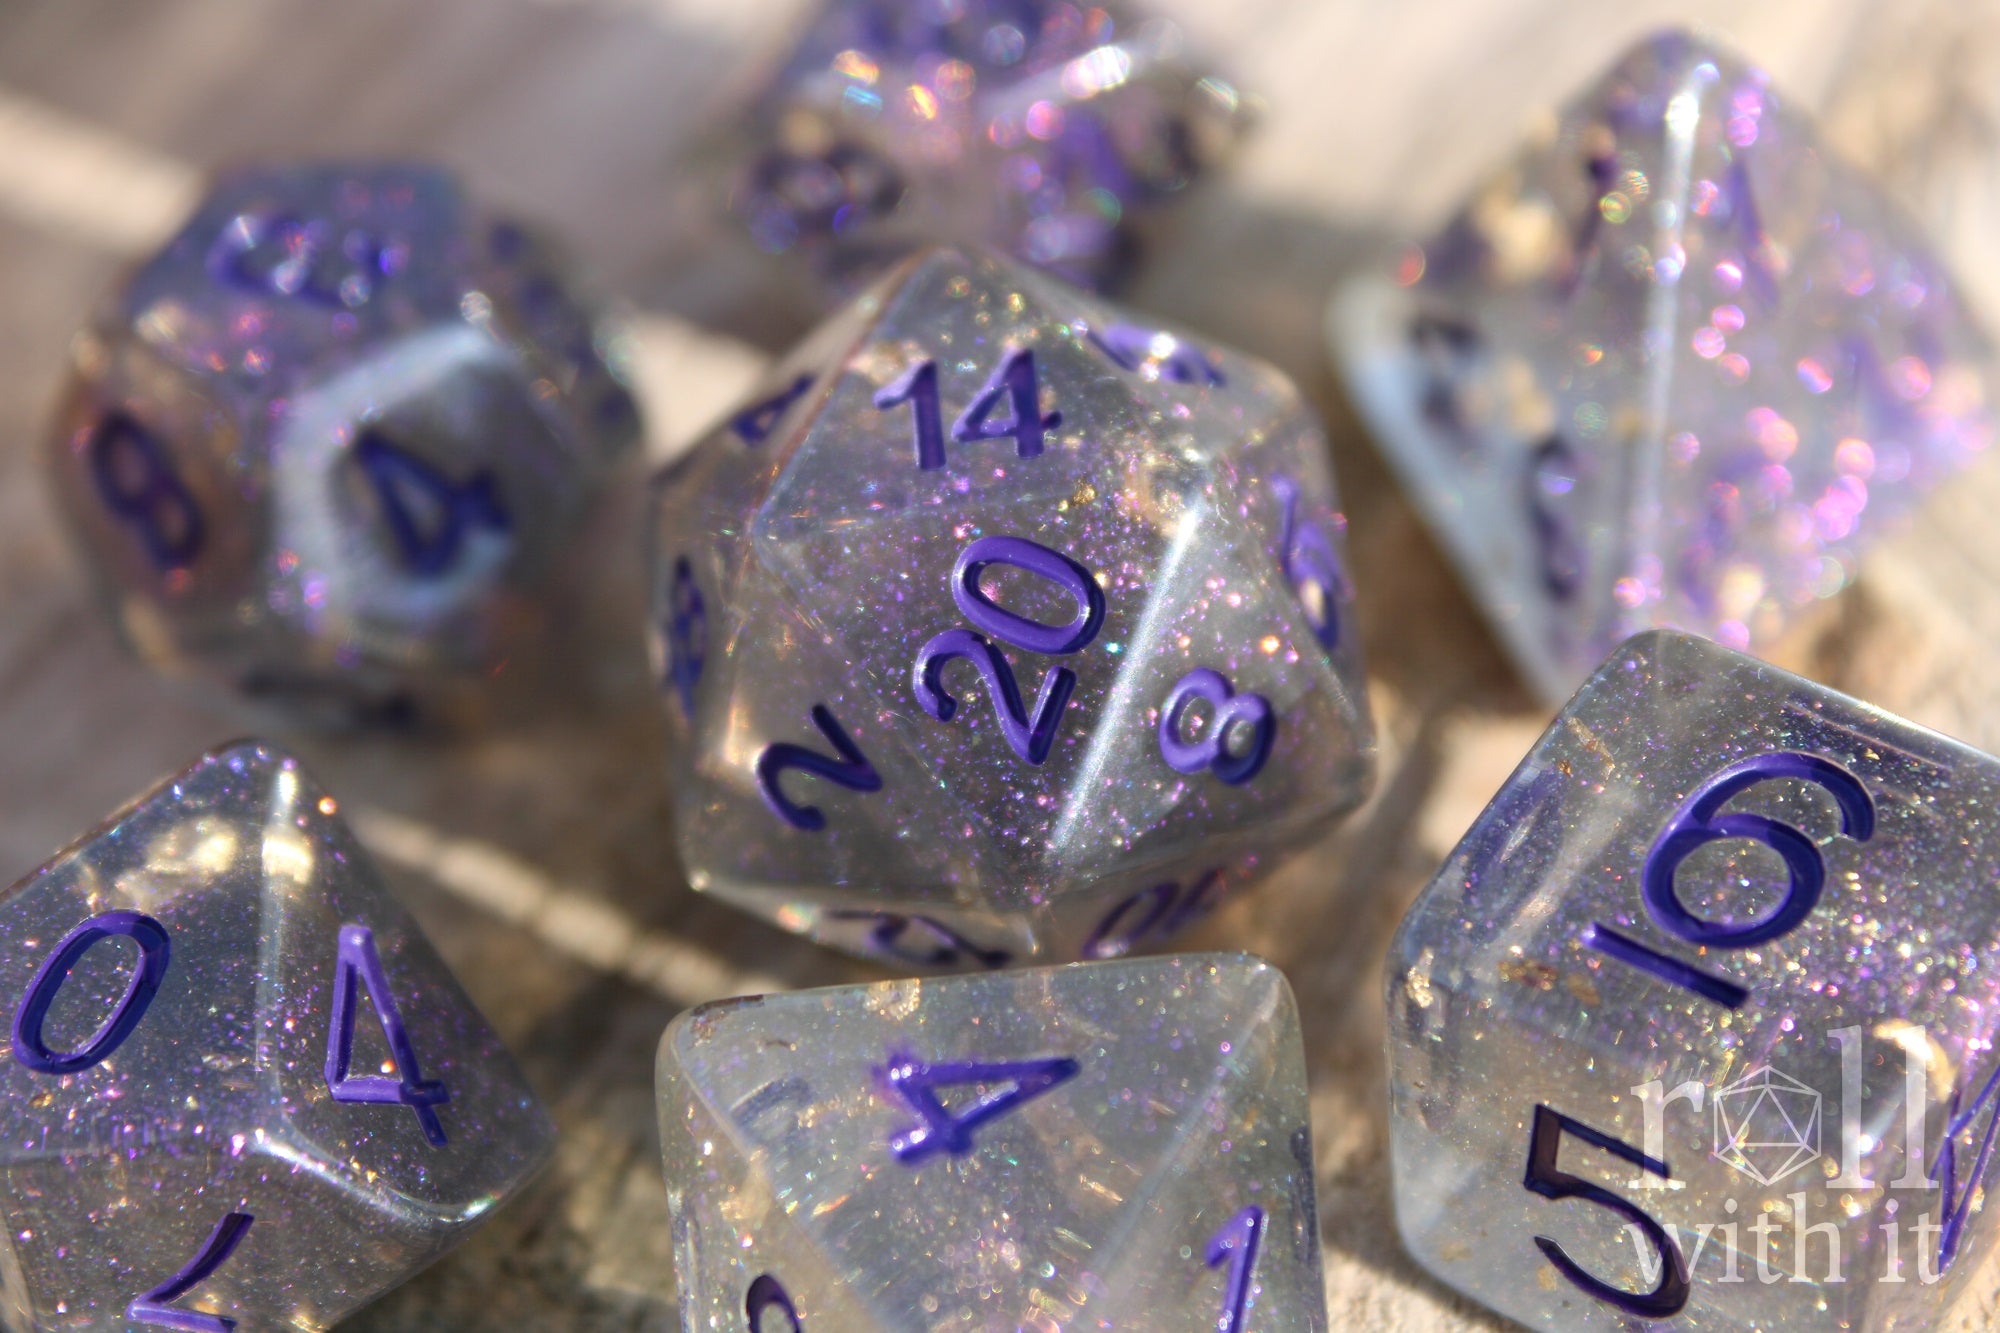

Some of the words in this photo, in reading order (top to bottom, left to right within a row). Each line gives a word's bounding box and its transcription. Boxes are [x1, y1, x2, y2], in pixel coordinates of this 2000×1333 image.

[874, 349, 1062, 470] 14
[88, 410, 206, 570] 8
[352, 428, 514, 580] 4
[912, 535, 1106, 766] 20
[1158, 667, 1276, 785] 8
[755, 703, 883, 831] 2
[10, 909, 171, 1076] 0
[324, 924, 451, 1148] 4
[876, 1050, 1082, 1164] 4
[1206, 1206, 1264, 1333] 1
[1523, 1103, 1690, 1318] 5
